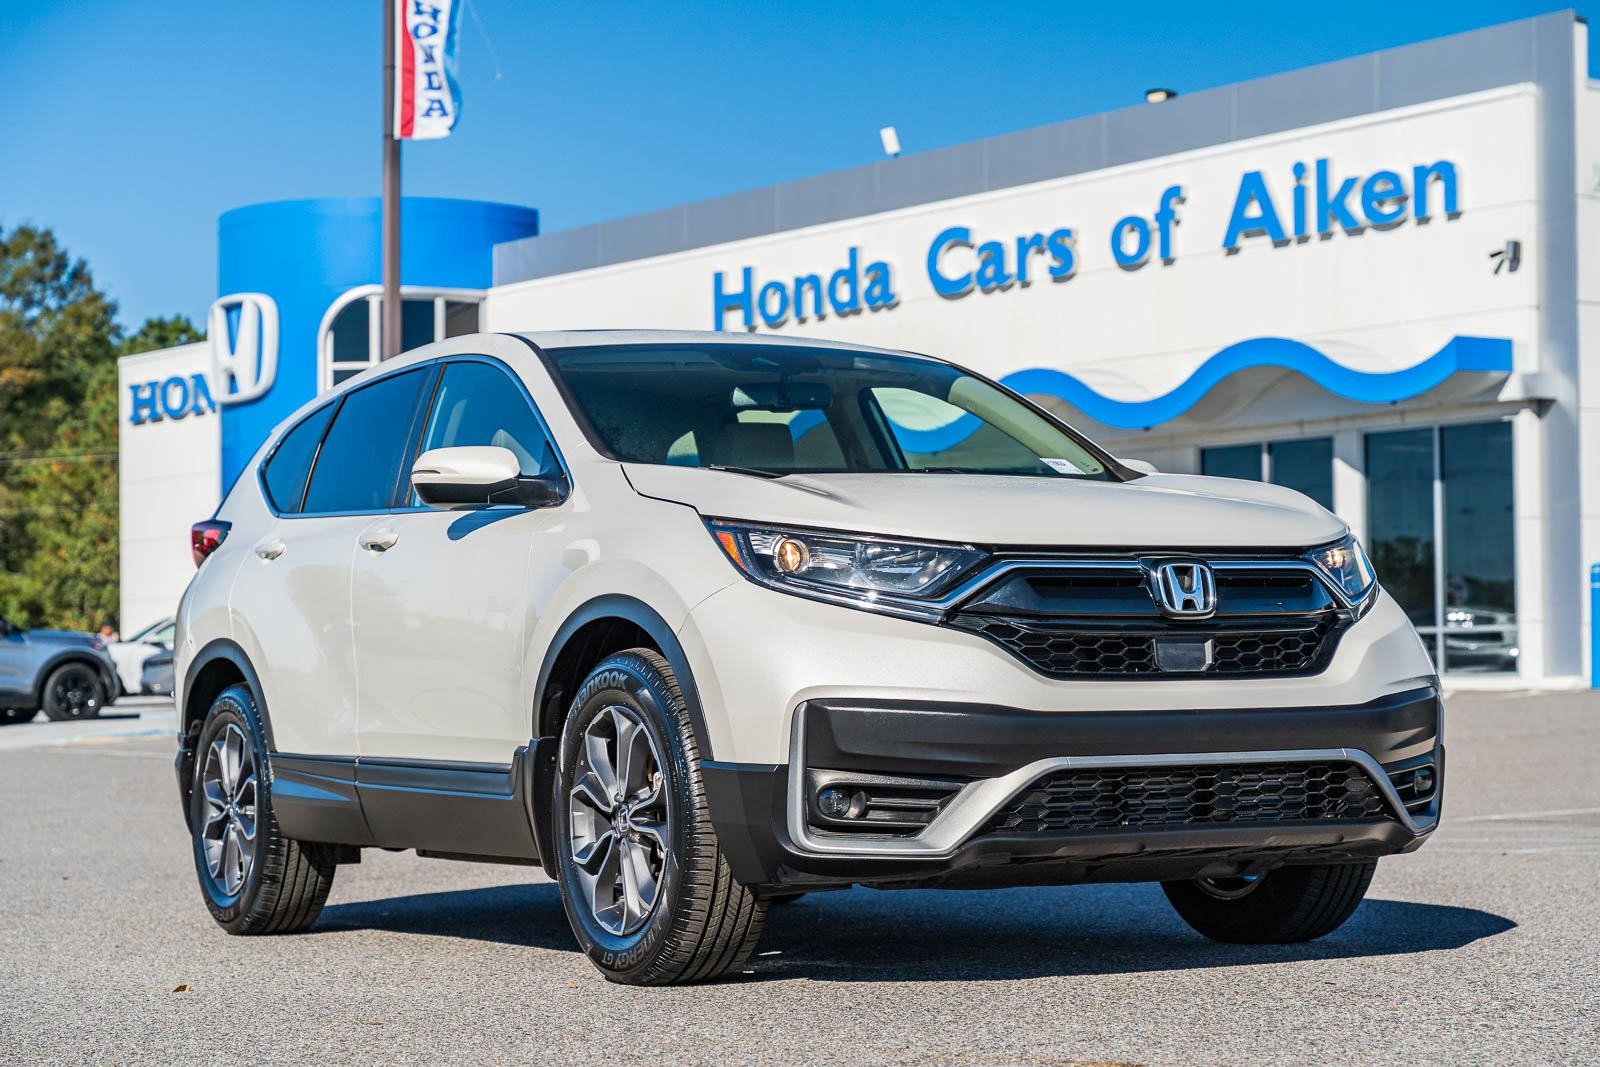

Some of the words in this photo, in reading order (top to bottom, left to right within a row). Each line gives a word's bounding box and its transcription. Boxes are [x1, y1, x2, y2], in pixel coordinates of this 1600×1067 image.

[713, 246, 897, 332] Honda
[926, 225, 1075, 296] Cars
[1111, 185, 1183, 267] of
[1222, 157, 1458, 250] Aiken
